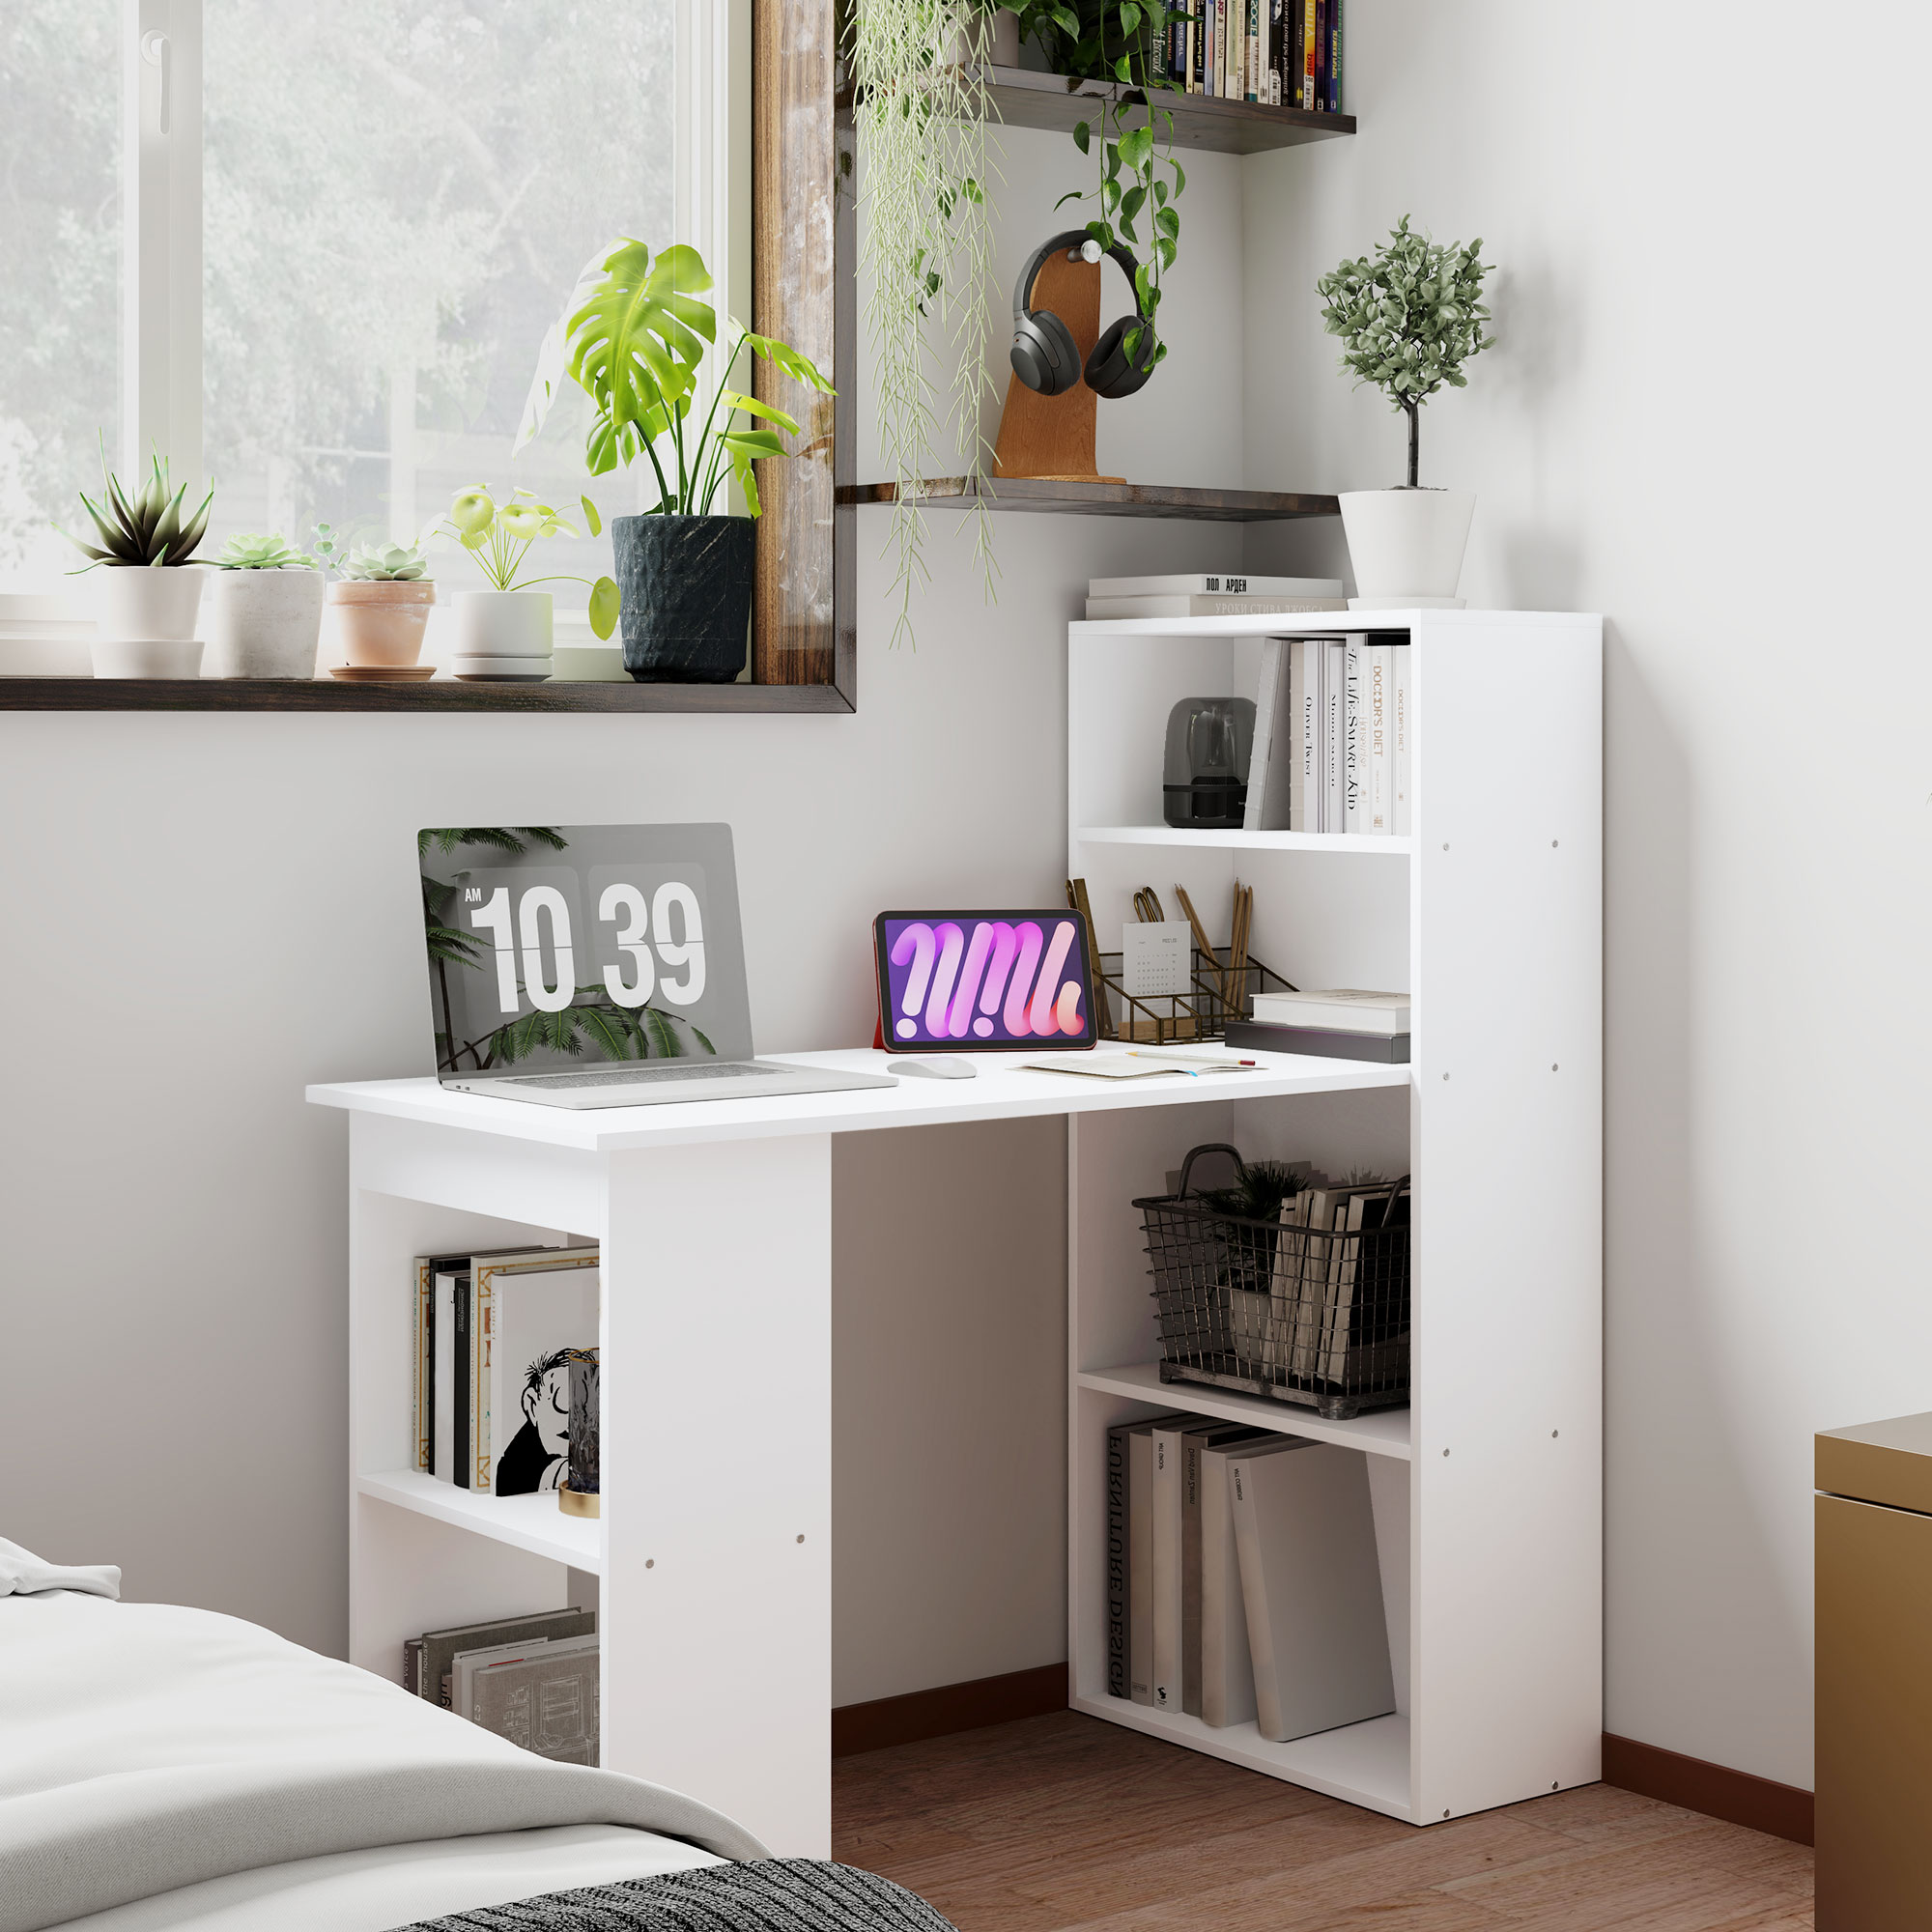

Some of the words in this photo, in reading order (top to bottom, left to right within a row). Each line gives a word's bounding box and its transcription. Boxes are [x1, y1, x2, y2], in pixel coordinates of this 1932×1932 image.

[1207, 578, 1220, 591] ПОЛ
[1226, 579, 1247, 594] АРДЕН
[1215, 602, 1248, 614] УРОКИ
[1373, 729, 1384, 757] DIET
[465, 888, 482, 902] AM
[470, 885, 576, 1013] 10
[599, 881, 706, 1009] 39
